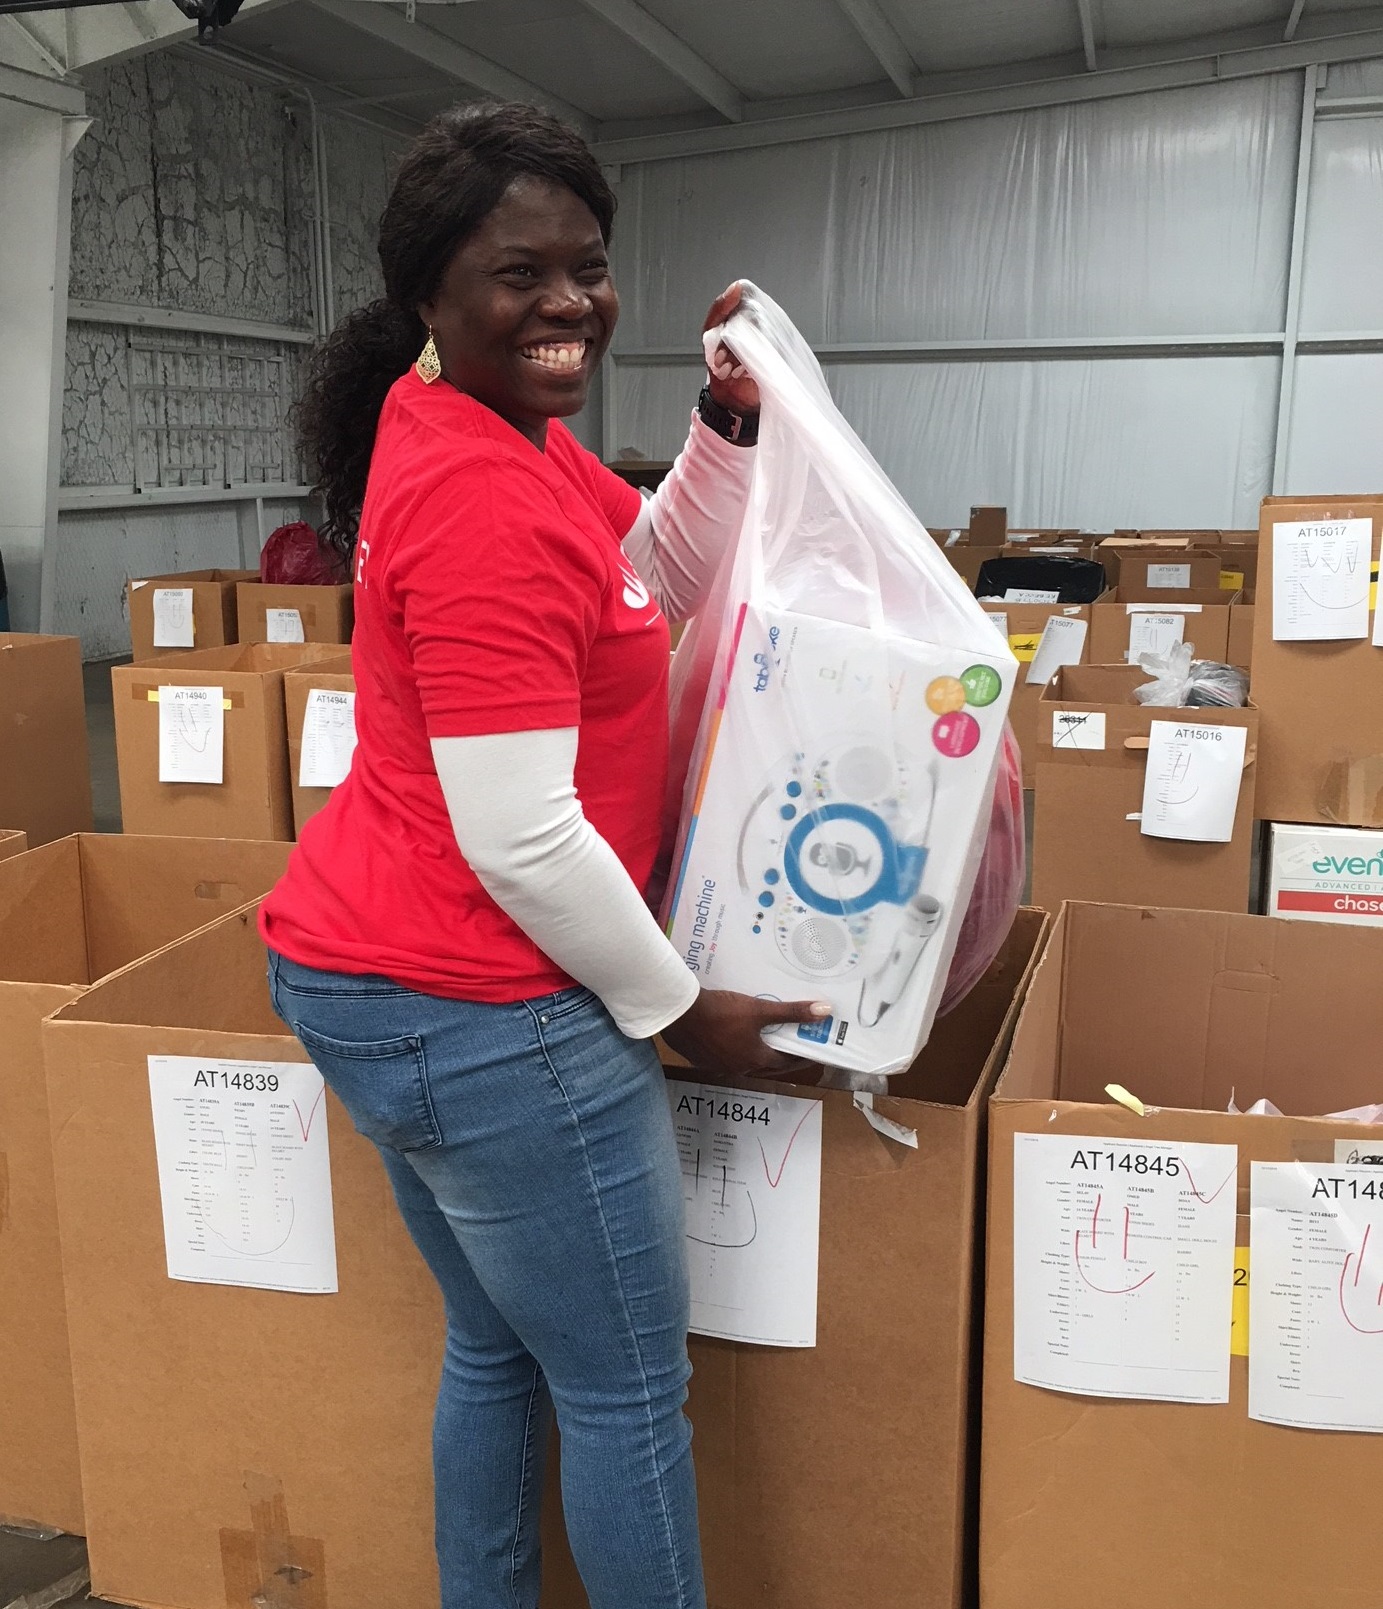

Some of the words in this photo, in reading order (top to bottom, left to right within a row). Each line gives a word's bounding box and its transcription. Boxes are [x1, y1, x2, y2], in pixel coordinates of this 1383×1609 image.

[1298, 526, 1347, 538] AT15017
[175, 691, 208, 700] AT14940
[316, 694, 348, 705] AT14944
[1175, 728, 1223, 742] AT15016
[1315, 881, 1371, 892] ADVANCED
[693, 879, 716, 938] machine
[705, 953, 716, 975] creating
[711, 920, 722, 942] through
[194, 1069, 279, 1092] AT14839
[676, 1095, 770, 1126] AT14844
[1070, 1150, 1180, 1177] AT14845
[1077, 1182, 1104, 1190] AT14845A
[1127, 1186, 1155, 1194] AT14845B
[1309, 1211, 1338, 1219] AT14845D
